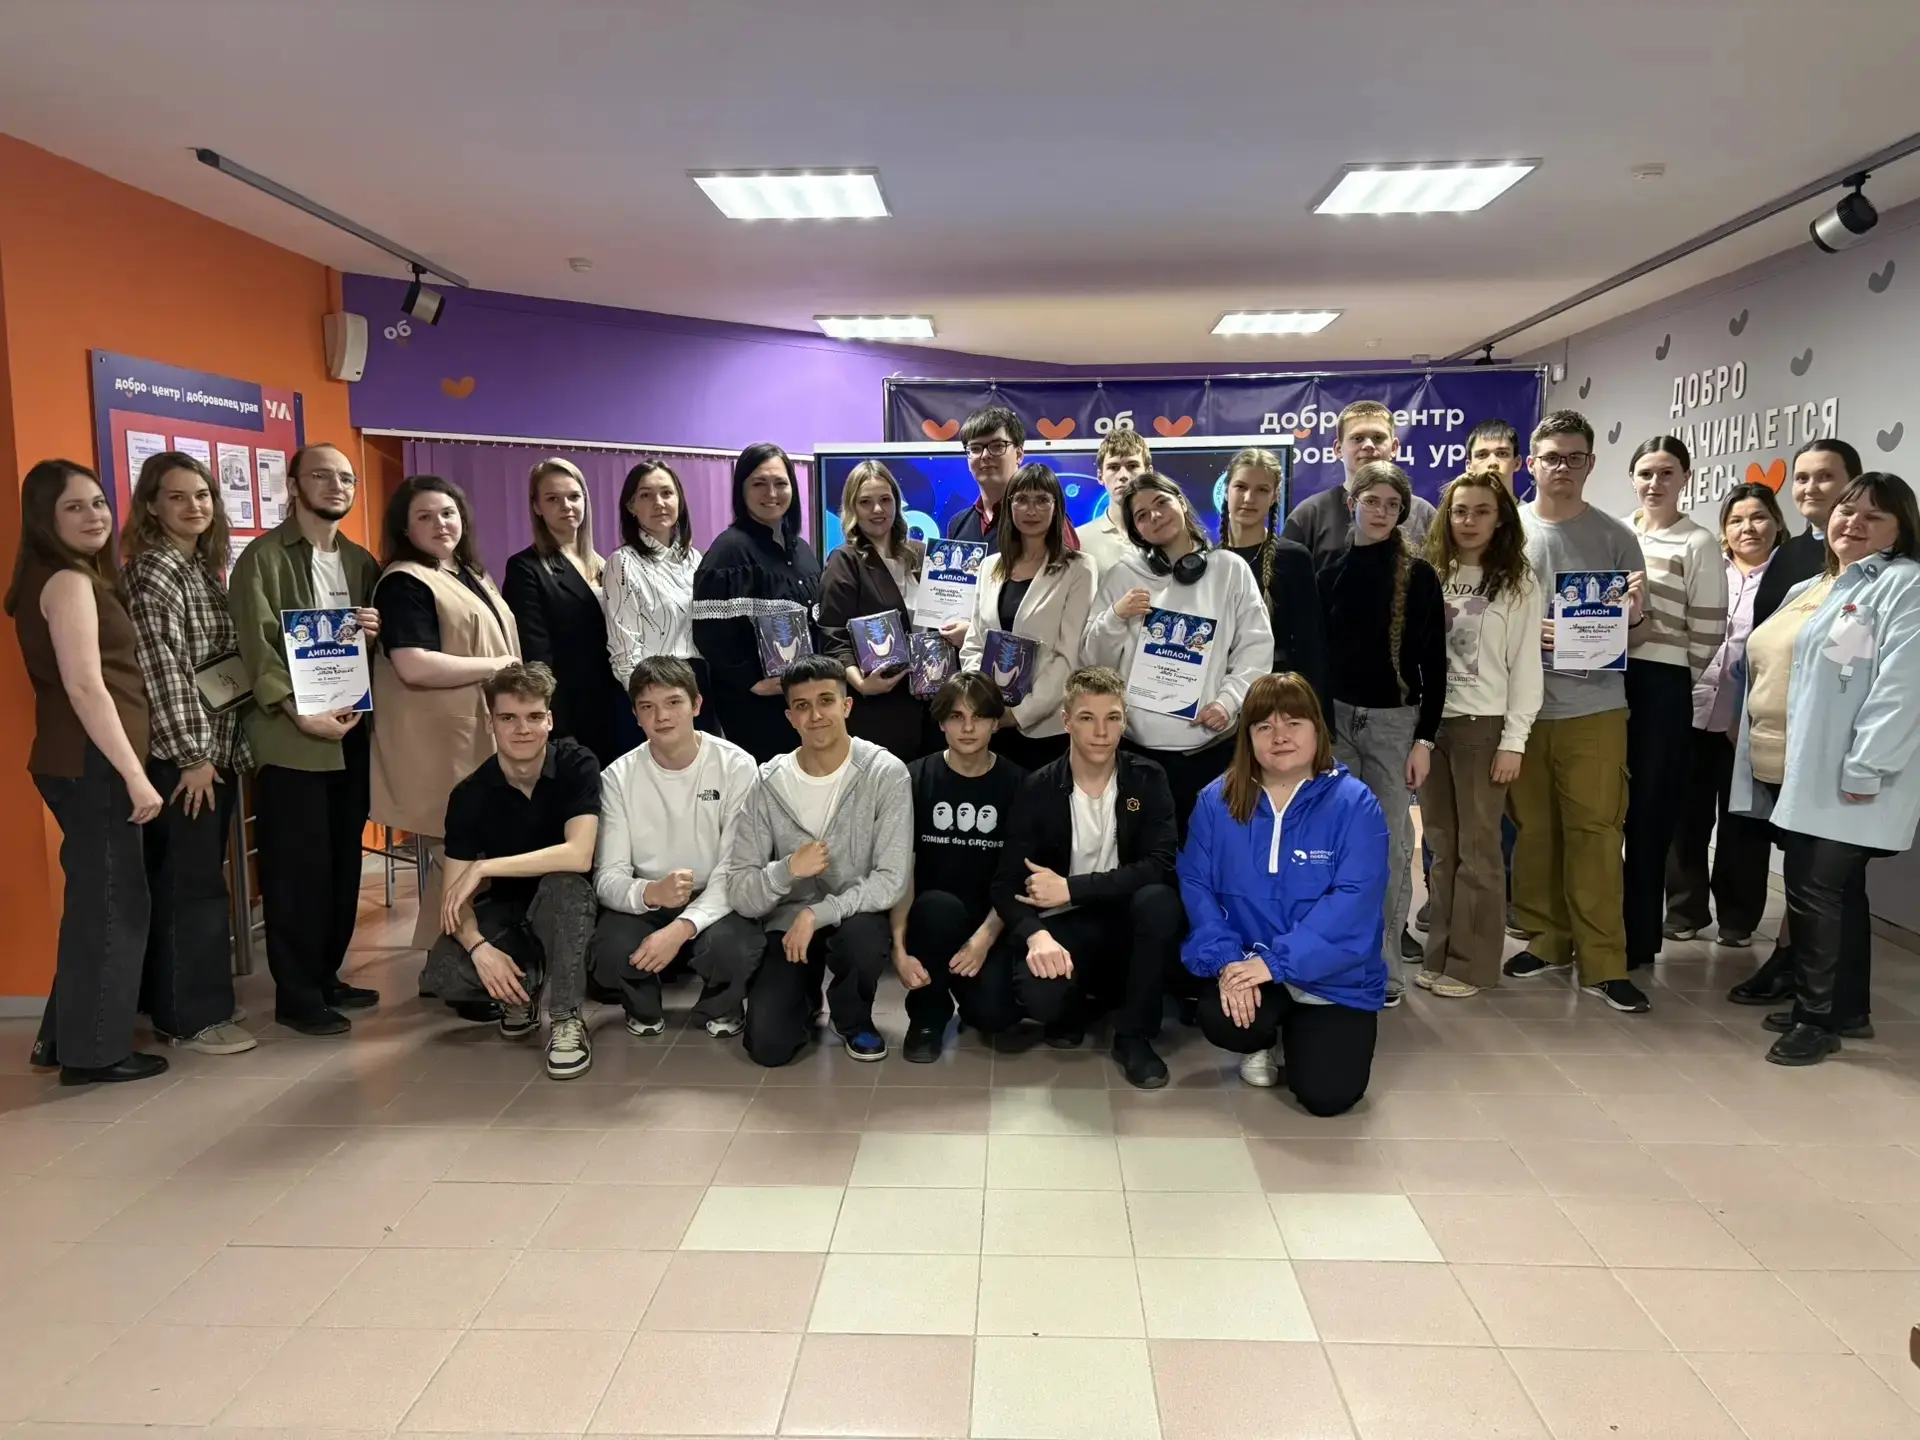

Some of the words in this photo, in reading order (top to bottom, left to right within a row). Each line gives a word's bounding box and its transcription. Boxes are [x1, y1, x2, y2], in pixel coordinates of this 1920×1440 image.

[383, 320, 411, 339] об
[115, 377, 147, 394] добро
[152, 384, 180, 400] центр
[187, 391, 240, 411] доброволец
[1669, 361, 1747, 419] ДОБРО
[1094, 410, 1134, 434] об
[1260, 404, 1340, 434] добр
[1392, 408, 1465, 432] ентр
[1679, 464, 1741, 510] ДЕСЬ
[938, 573, 968, 582] ДИПЛОМ
[1573, 608, 1610, 616] ДИПЛОМ
[307, 648, 346, 657] ДИПЛОМ
[1155, 647, 1191, 660] ДИПЛОМ
[921, 834, 950, 844] COMME
